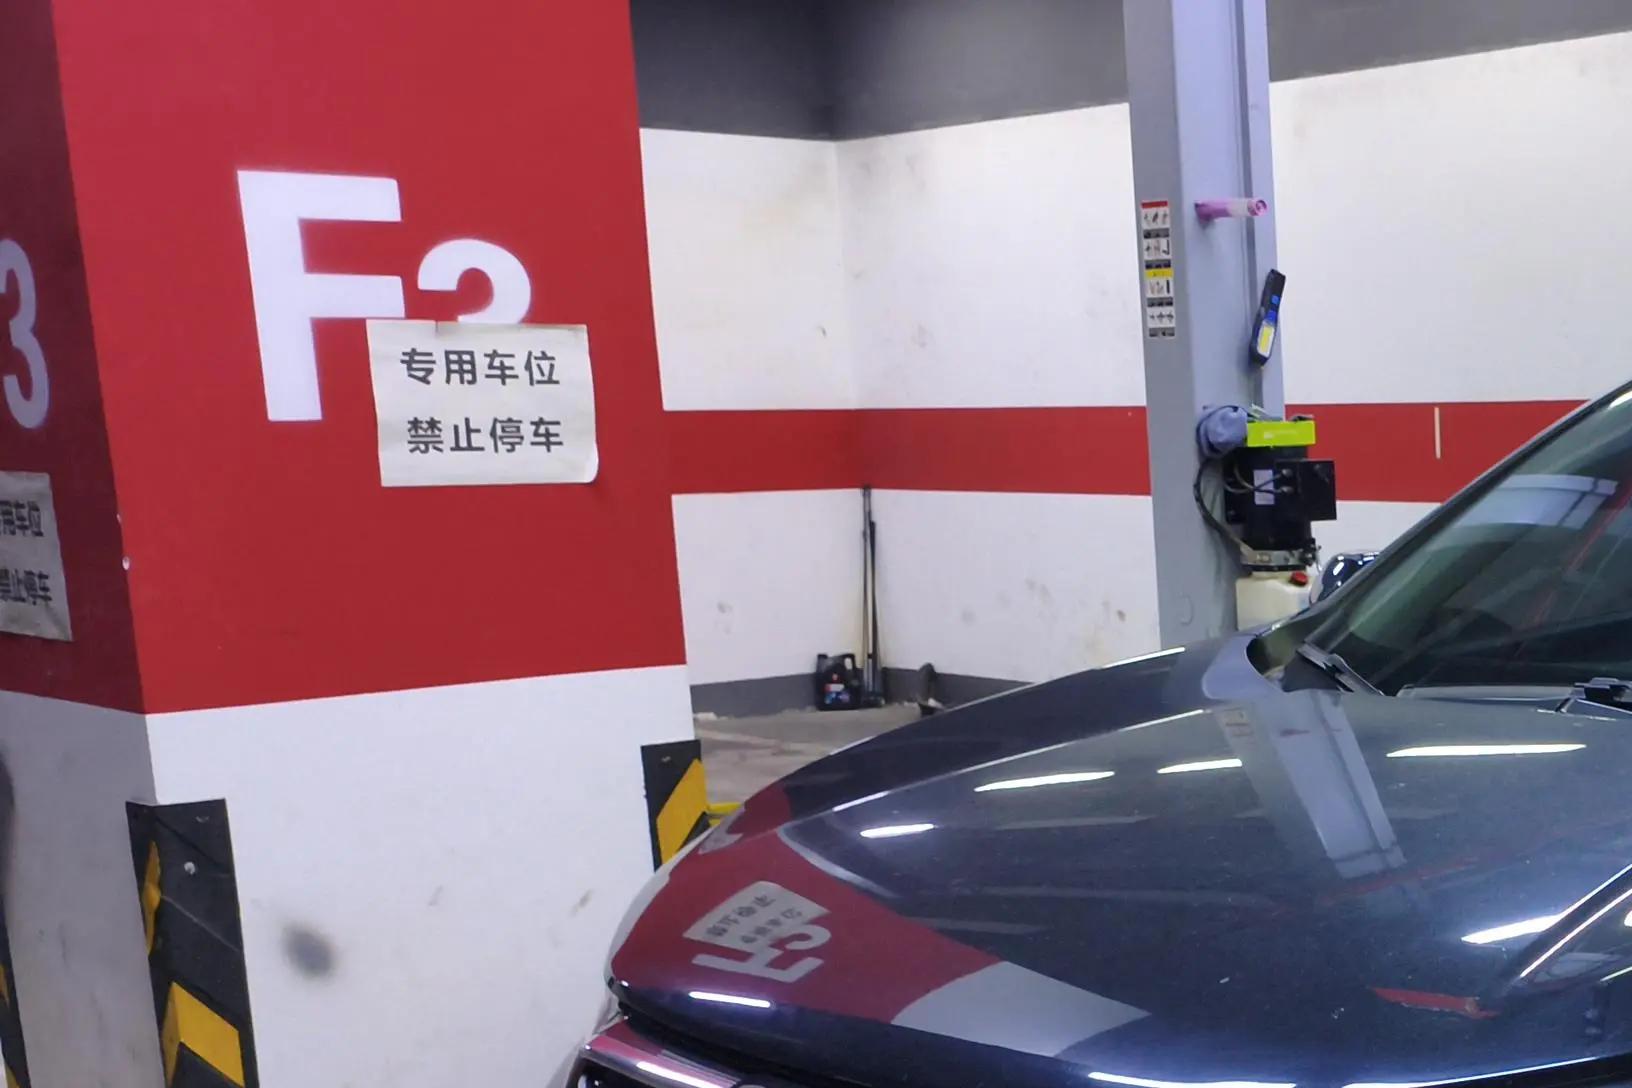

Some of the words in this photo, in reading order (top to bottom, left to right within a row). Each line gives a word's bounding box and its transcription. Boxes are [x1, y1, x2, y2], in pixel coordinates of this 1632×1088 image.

[400, 347, 560, 386] 专用车位
[407, 416, 564, 454] 禁止停车
